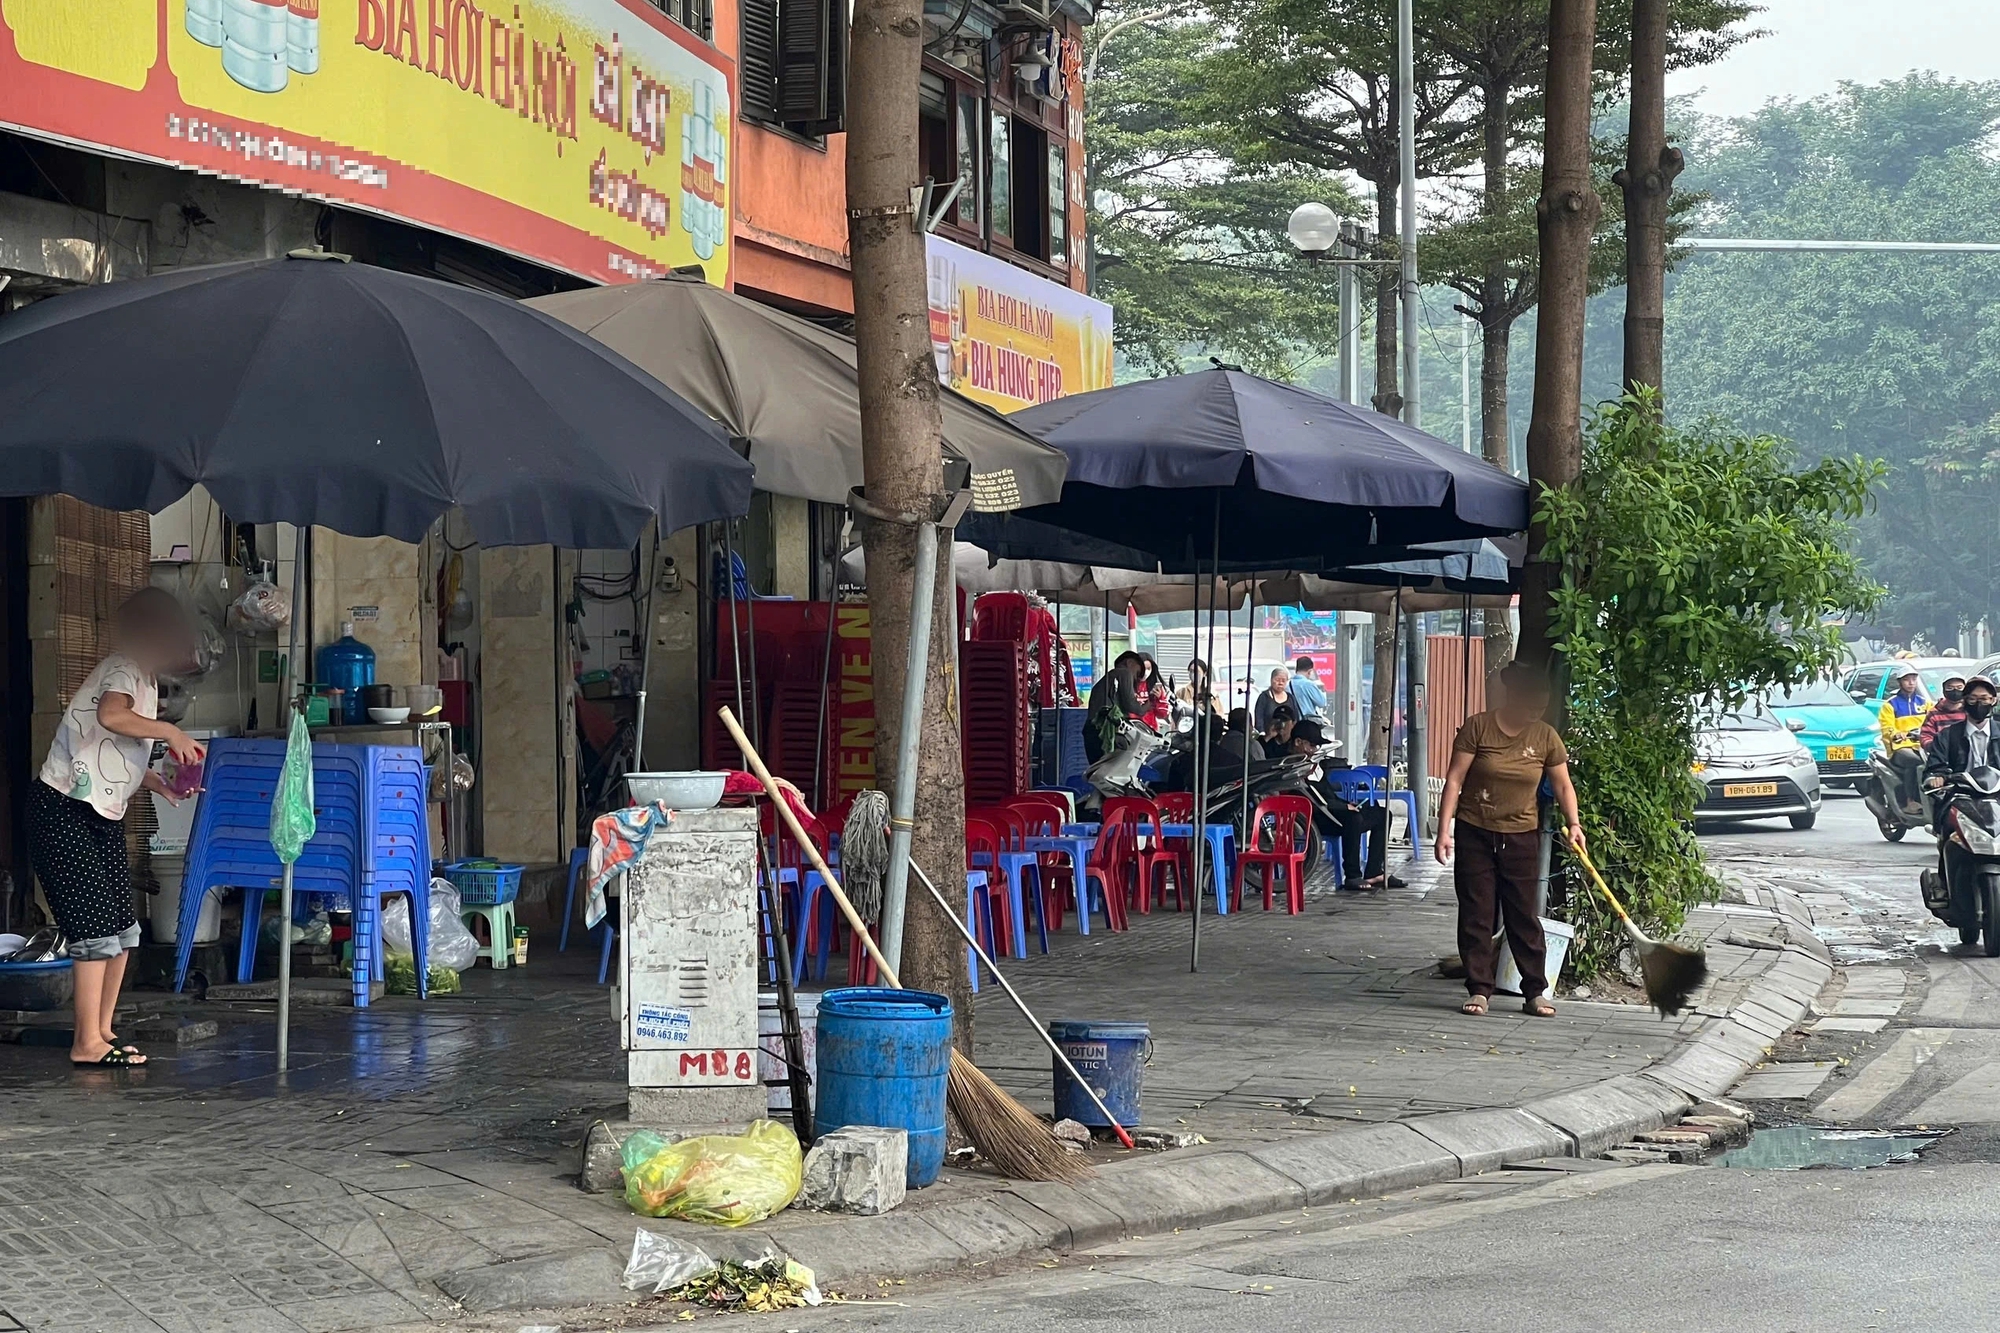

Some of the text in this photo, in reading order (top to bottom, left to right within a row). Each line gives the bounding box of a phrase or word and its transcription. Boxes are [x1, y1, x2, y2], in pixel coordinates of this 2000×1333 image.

[354, 0, 422, 70] BIA
[977, 285, 996, 322] BIA
[1020, 296, 1035, 334] HÀ
[971, 339, 995, 391] BIA
[997, 340, 1034, 401] HÙNG
[1001, 489, 1019, 497] 023
[637, 1027, 688, 1041] 0946.463.892
[1066, 1046, 1104, 1057] JOTUN
